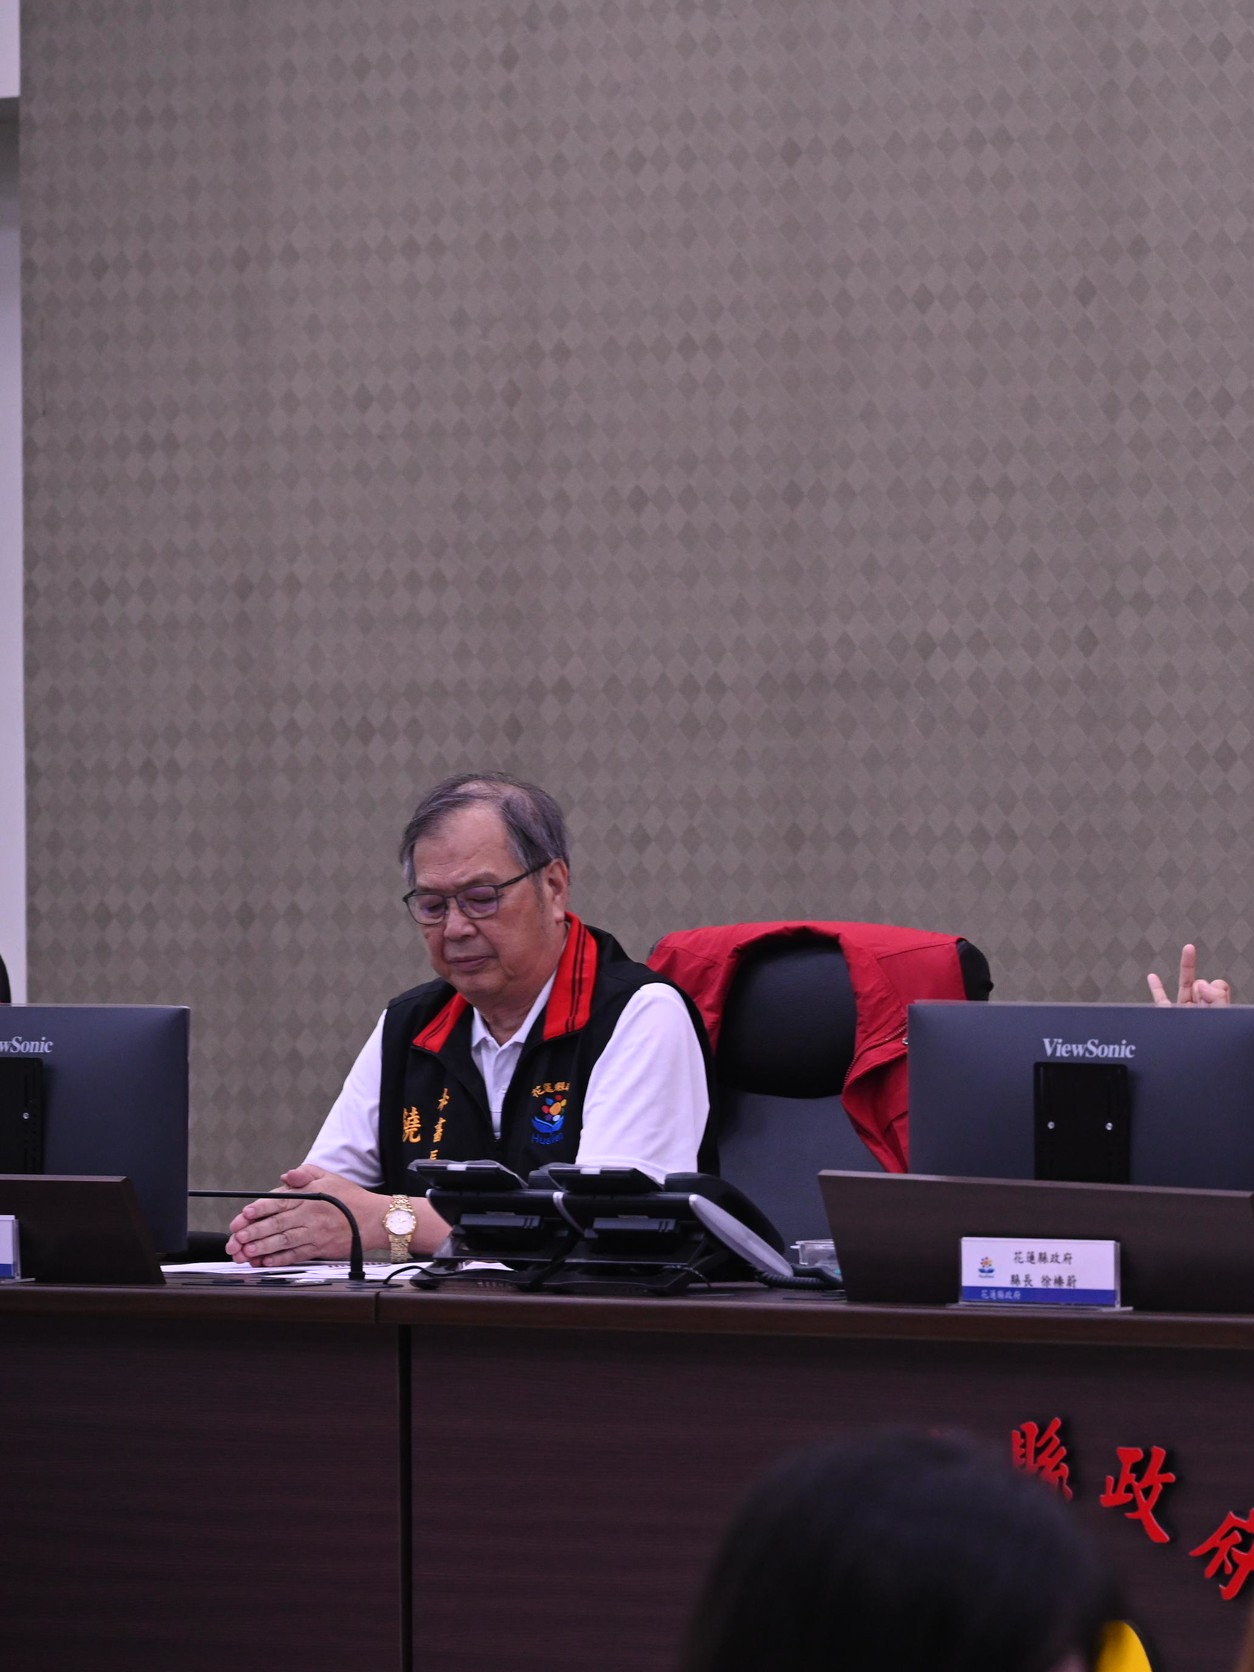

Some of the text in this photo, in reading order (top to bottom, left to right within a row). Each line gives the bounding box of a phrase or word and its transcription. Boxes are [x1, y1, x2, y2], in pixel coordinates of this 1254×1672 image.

[1043, 1037, 1136, 1059] ViewSonic
[1013, 1250, 1073, 1265] 花蓮縣政府
[1010, 1273, 1034, 1287] 縣長
